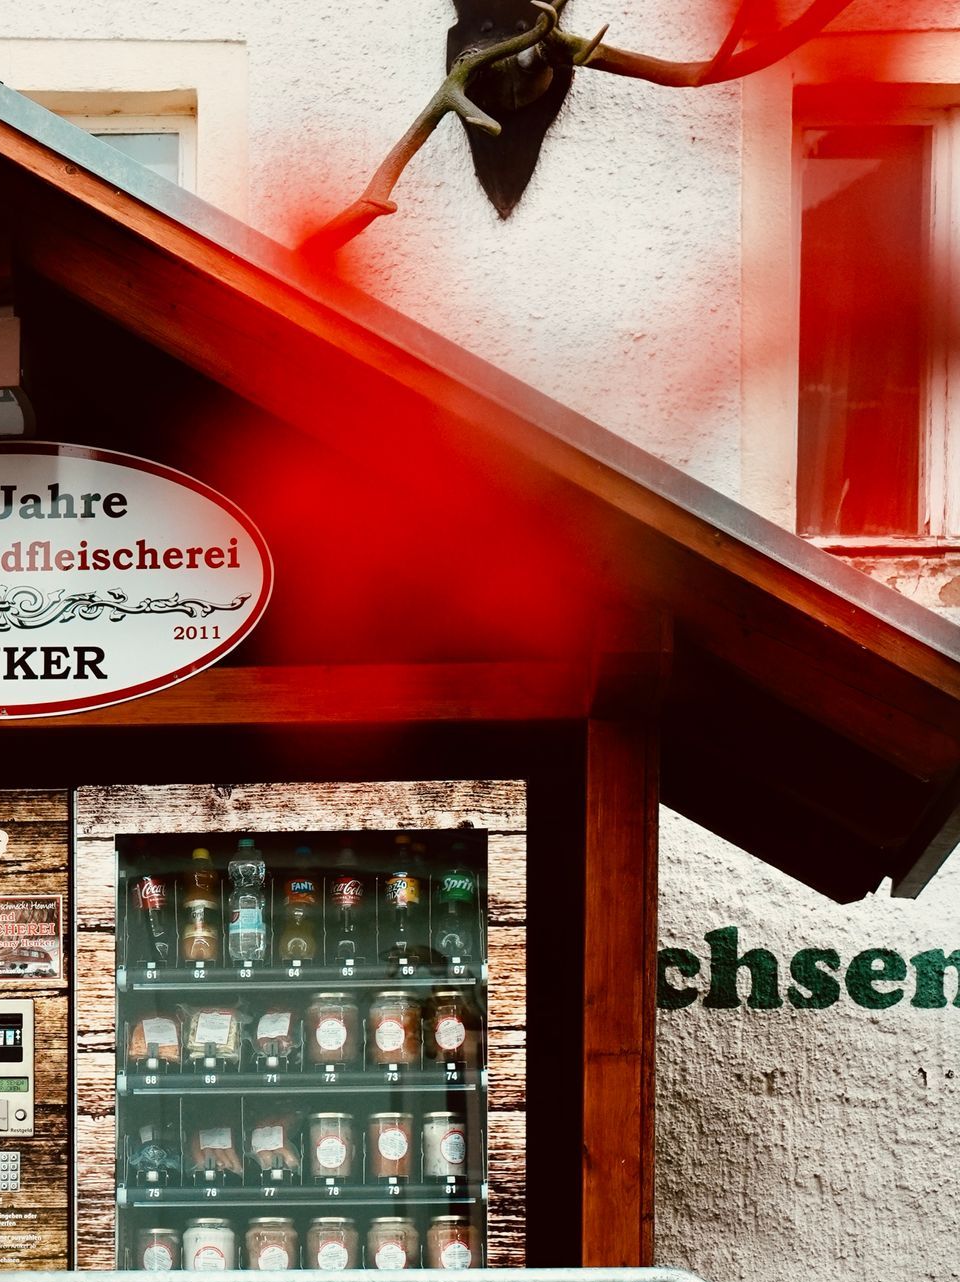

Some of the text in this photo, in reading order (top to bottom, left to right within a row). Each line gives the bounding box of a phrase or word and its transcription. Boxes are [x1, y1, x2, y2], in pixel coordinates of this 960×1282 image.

[173, 626, 221, 641] 2011
[291, 882, 314, 891] FANT
[147, 965, 465, 978] 61 62 63 64 65 66 67
[146, 1072, 457, 1084] 68 69 71 72 73 74
[149, 1185, 456, 1197] 75 76 77 78 79 81
